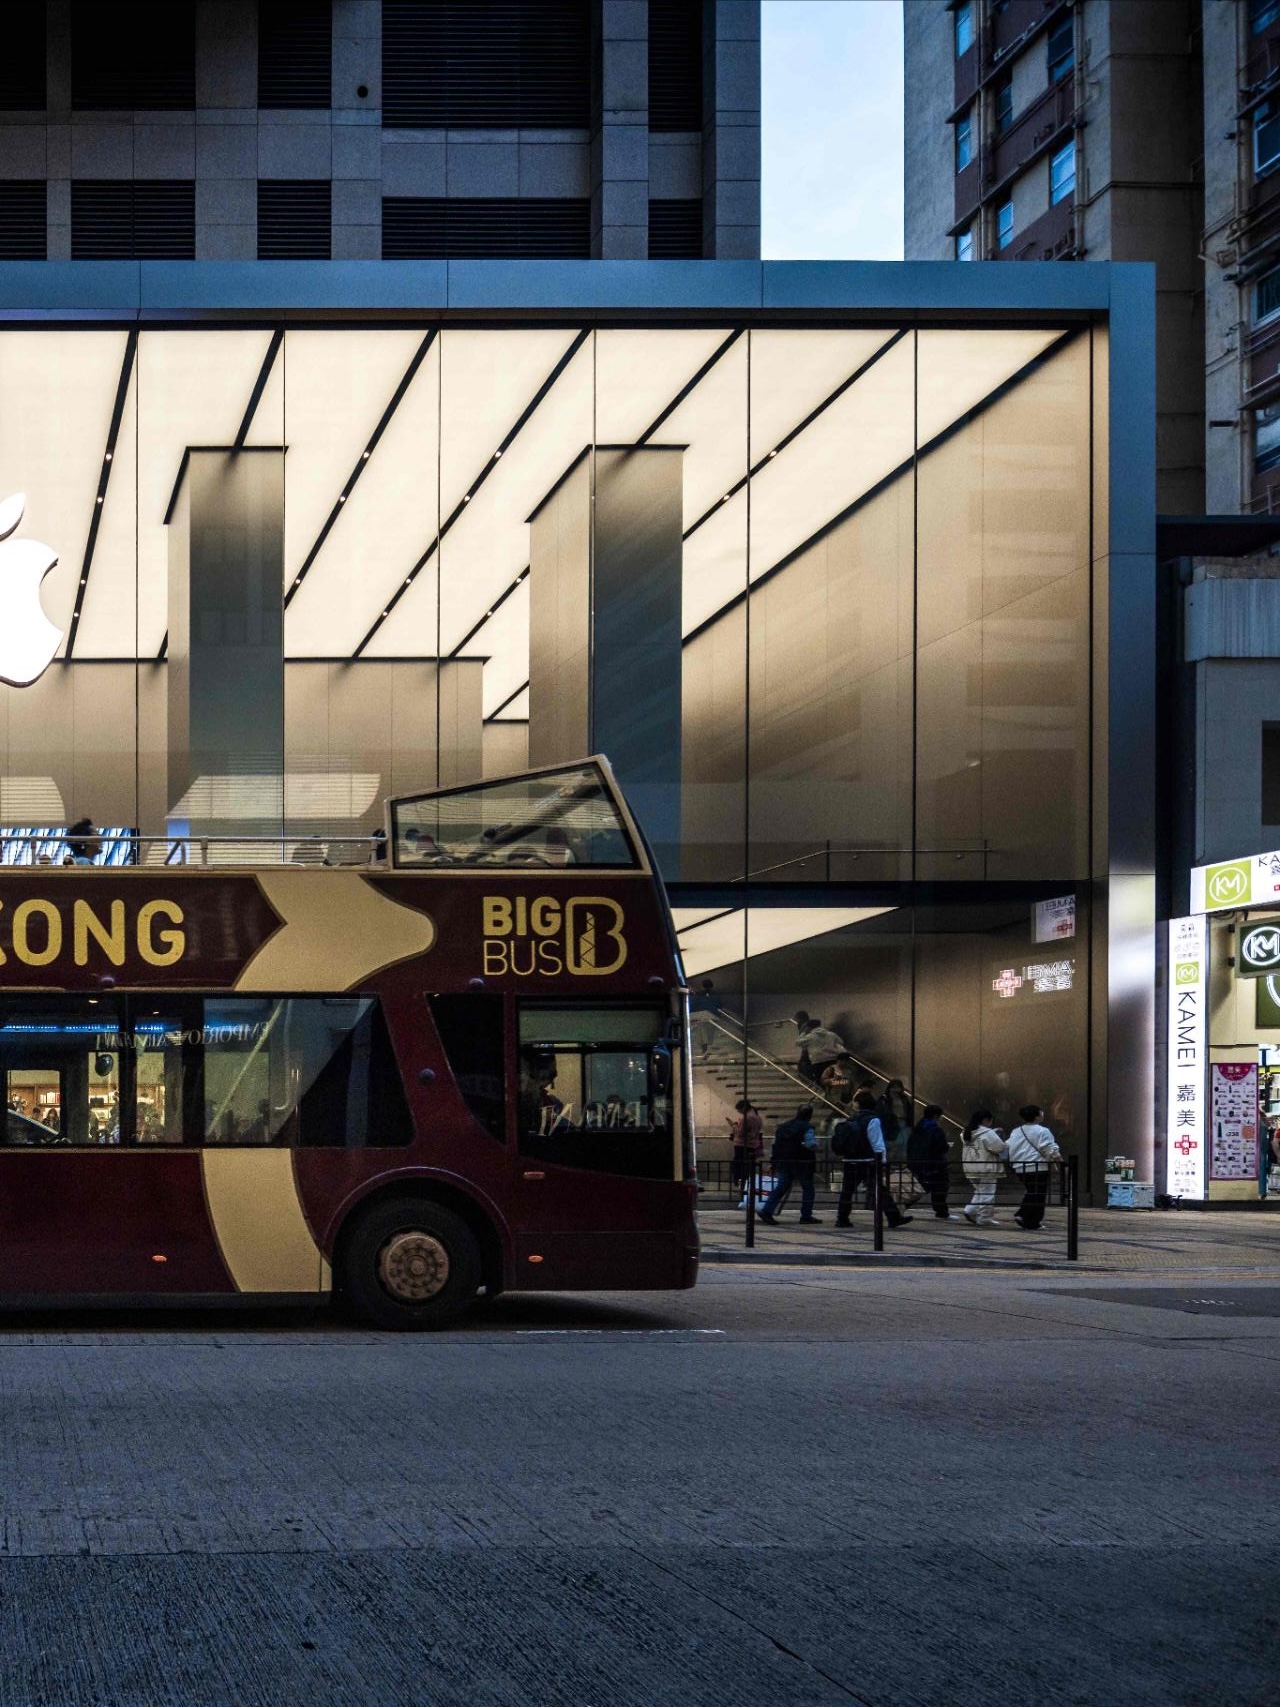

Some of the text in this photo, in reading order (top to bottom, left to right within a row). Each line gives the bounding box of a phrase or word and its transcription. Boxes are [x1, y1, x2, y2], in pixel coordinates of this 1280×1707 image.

[483, 896, 562, 936] BIG
[483, 940, 563, 976] BUS
[1177, 990, 1196, 1067] KAMEI
[1177, 1084, 1196, 1127] 嘉美
